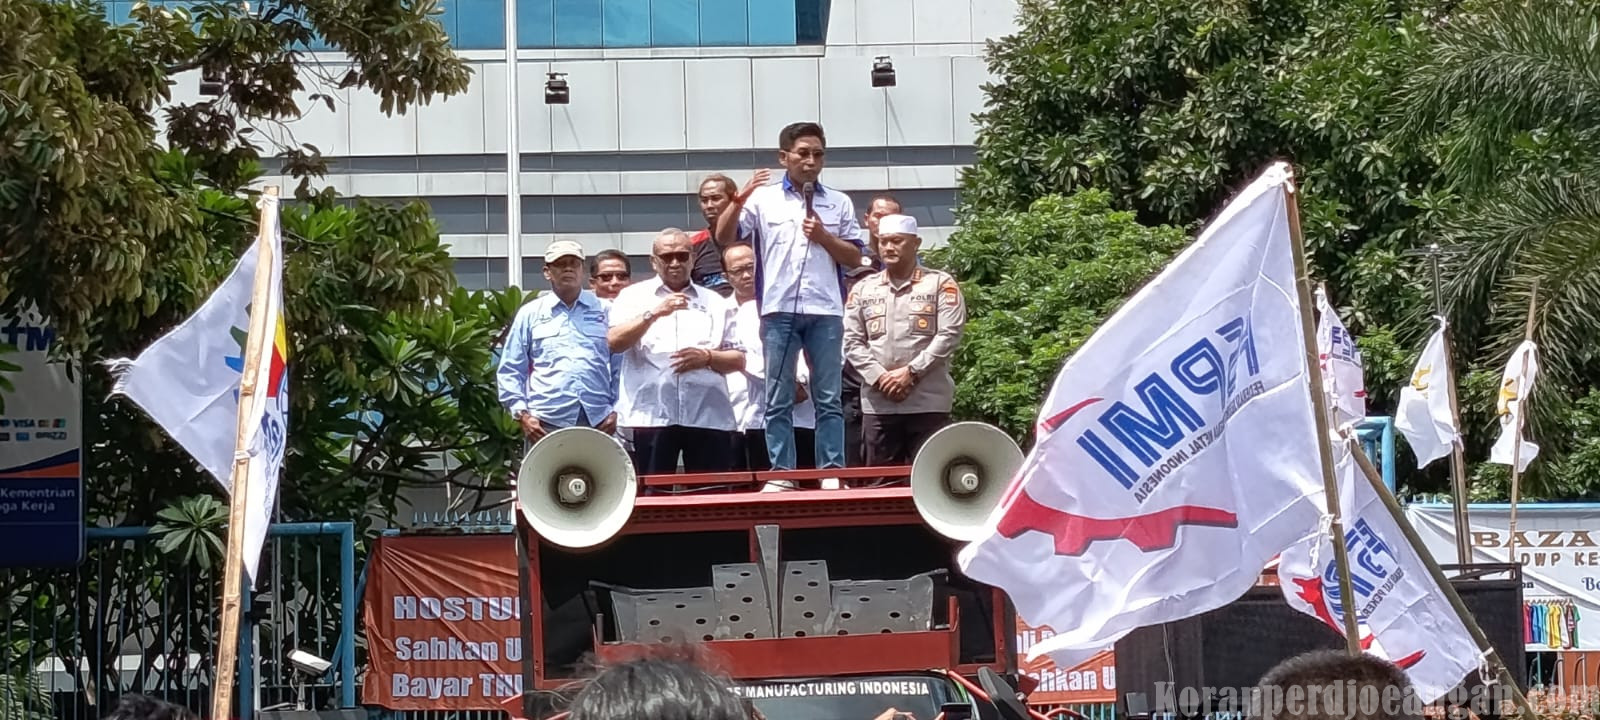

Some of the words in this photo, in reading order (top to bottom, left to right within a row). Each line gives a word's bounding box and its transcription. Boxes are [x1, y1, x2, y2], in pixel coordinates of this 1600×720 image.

[0, 487, 75, 498] Kementrian
[21, 500, 55, 513] Kerja
[1471, 530, 1600, 548] BAZA
[1520, 552, 1561, 567] DWP
[395, 636, 498, 661] Sahkan
[391, 673, 473, 699] Bayar
[745, 682, 856, 698] MANUFACTURING
[859, 682, 929, 696] INDONESIA
